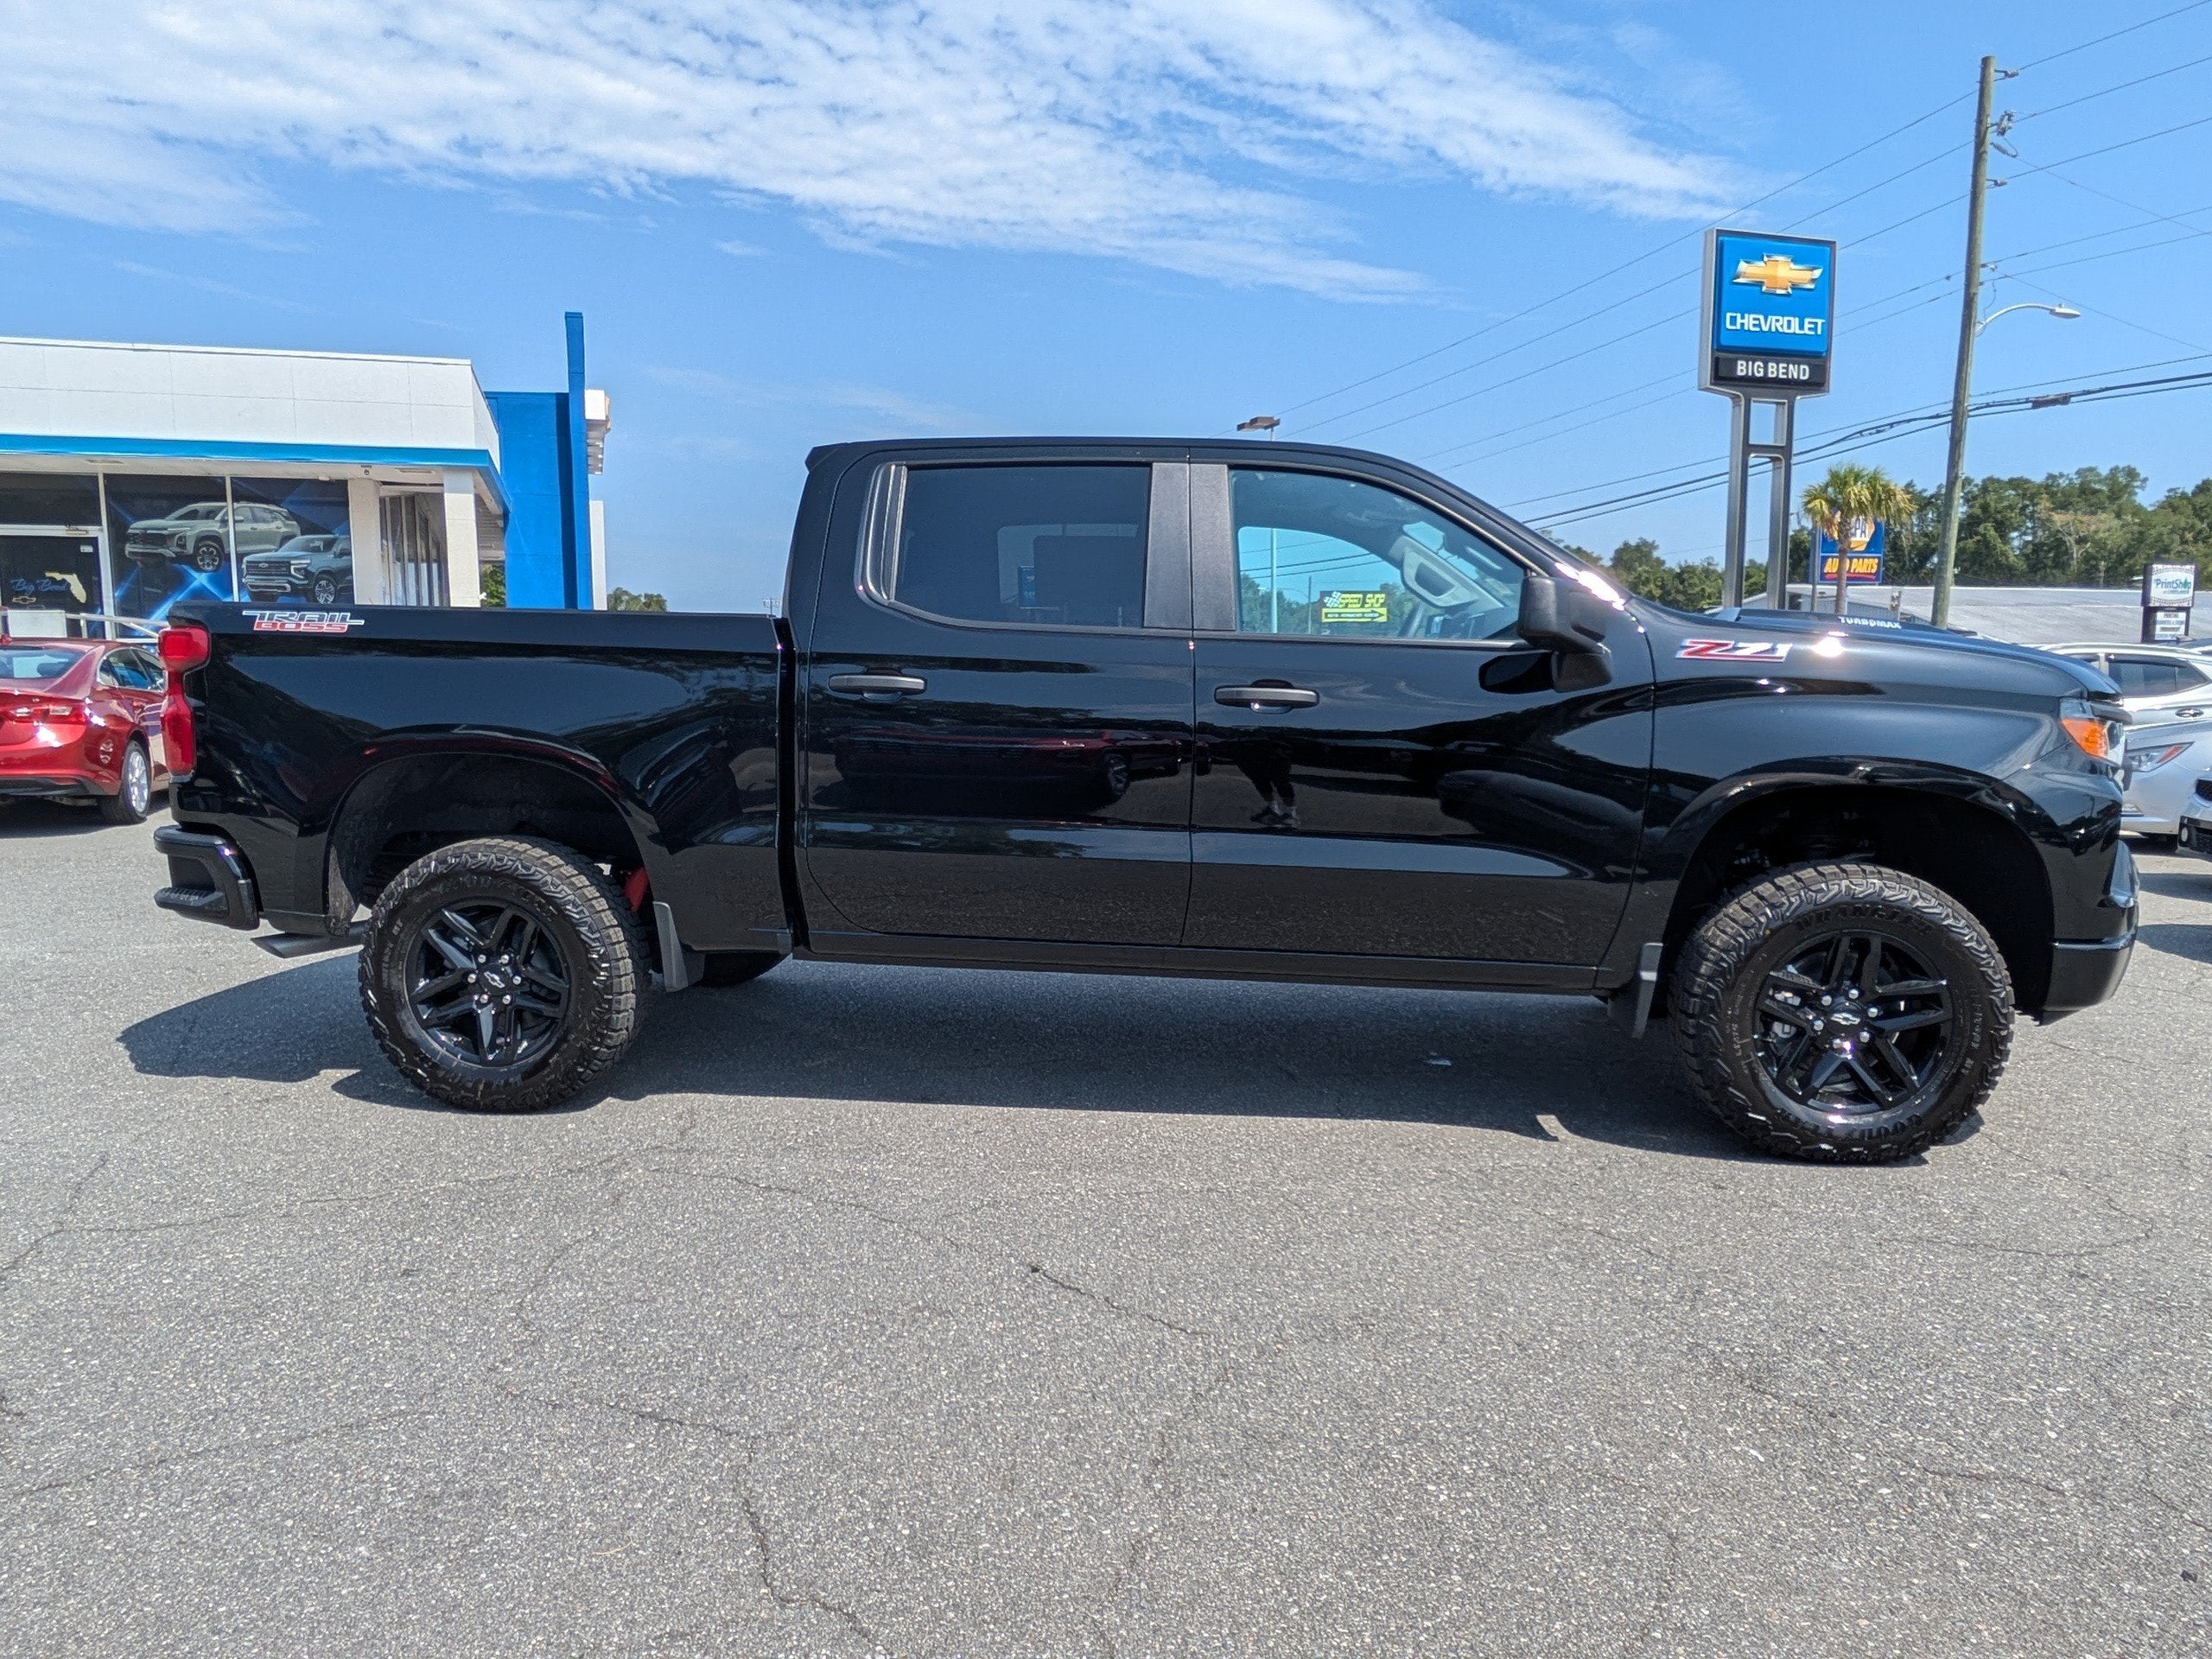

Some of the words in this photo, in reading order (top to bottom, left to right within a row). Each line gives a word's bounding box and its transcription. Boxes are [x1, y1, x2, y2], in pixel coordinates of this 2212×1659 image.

[1725, 311, 1827, 335] CHEVROLET
[1736, 359, 1764, 378] BIG
[1767, 361, 1810, 380] BEND
[1850, 557, 1879, 574] PARTS
[242, 610, 365, 625] TRAIL
[1837, 615, 1903, 629] TURBOMAX
[253, 621, 347, 633] BOSS
[1675, 639, 1793, 663] Z71
